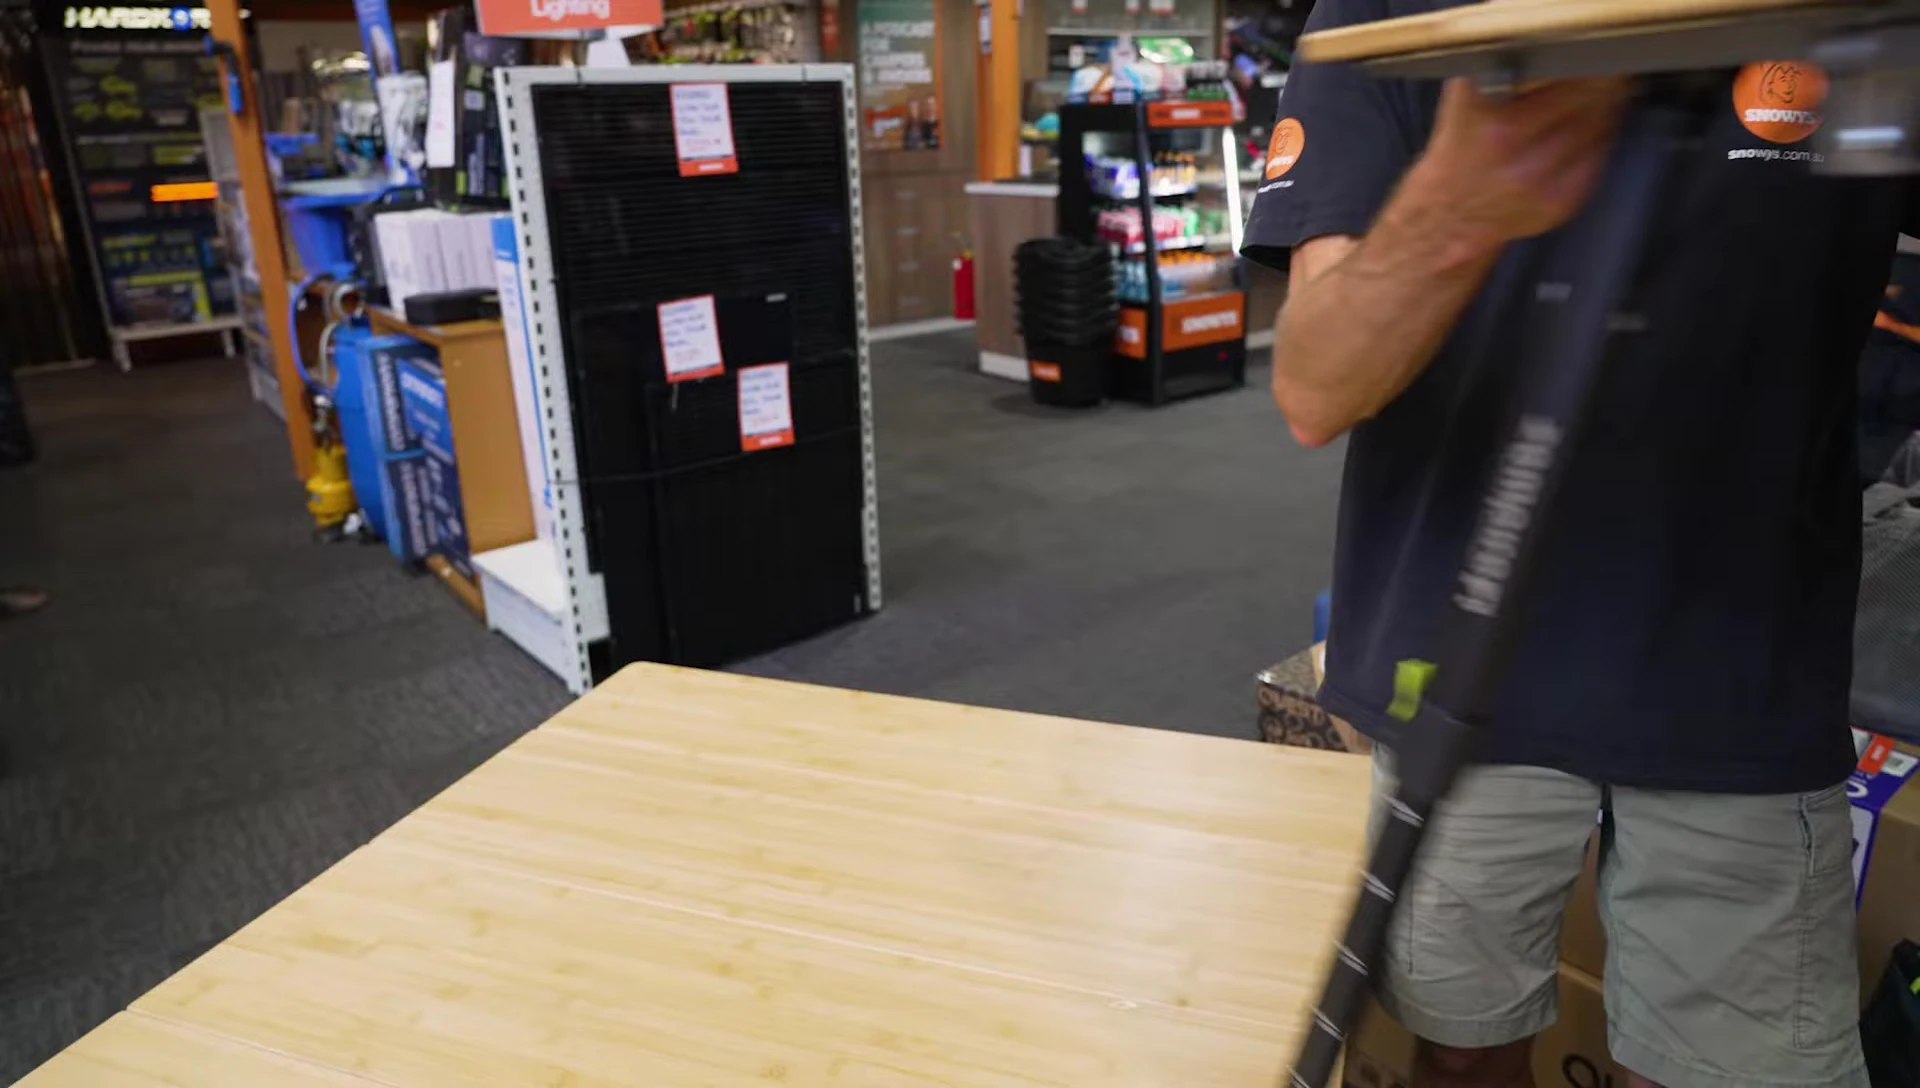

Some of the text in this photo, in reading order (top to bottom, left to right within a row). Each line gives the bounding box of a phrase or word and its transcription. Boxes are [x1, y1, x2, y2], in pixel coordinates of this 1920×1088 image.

[64, 6, 212, 29] HARDKOR
[531, 0, 610, 21] Lighting
[1745, 109, 1817, 124] SNOWYS
